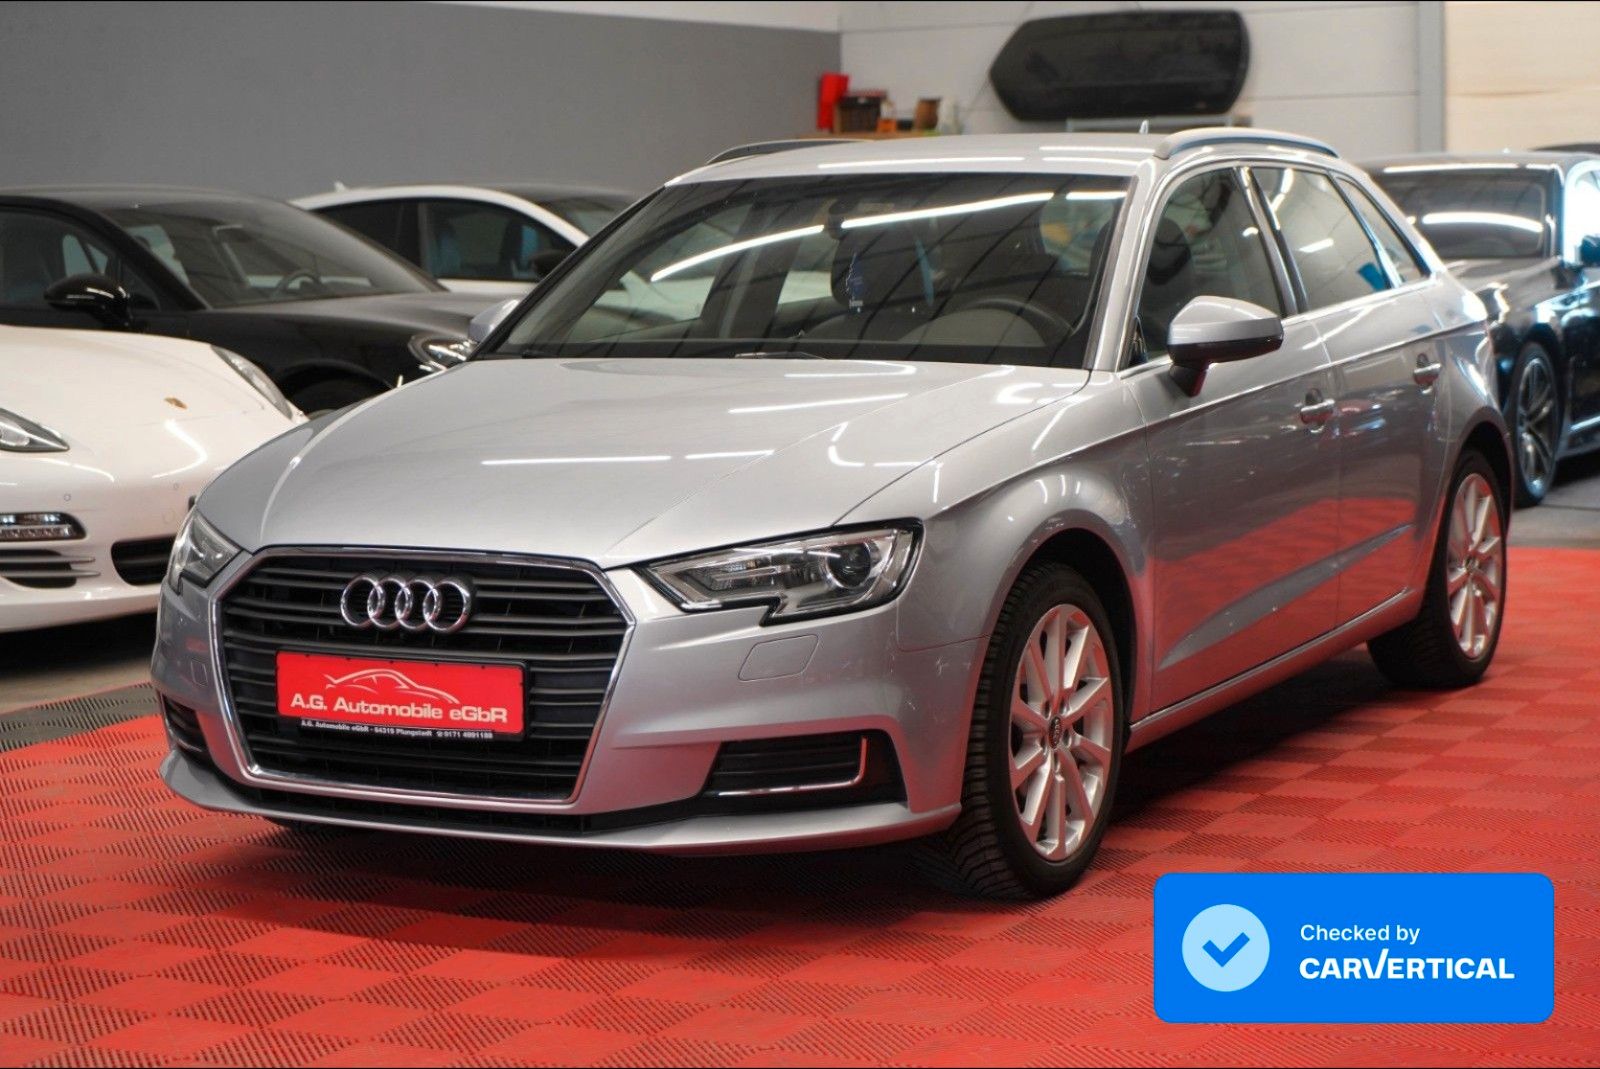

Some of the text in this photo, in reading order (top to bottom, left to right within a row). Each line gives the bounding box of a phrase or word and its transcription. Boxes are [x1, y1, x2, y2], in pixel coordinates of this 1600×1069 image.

[290, 693, 508, 723] A.G. Automobile eGbR
